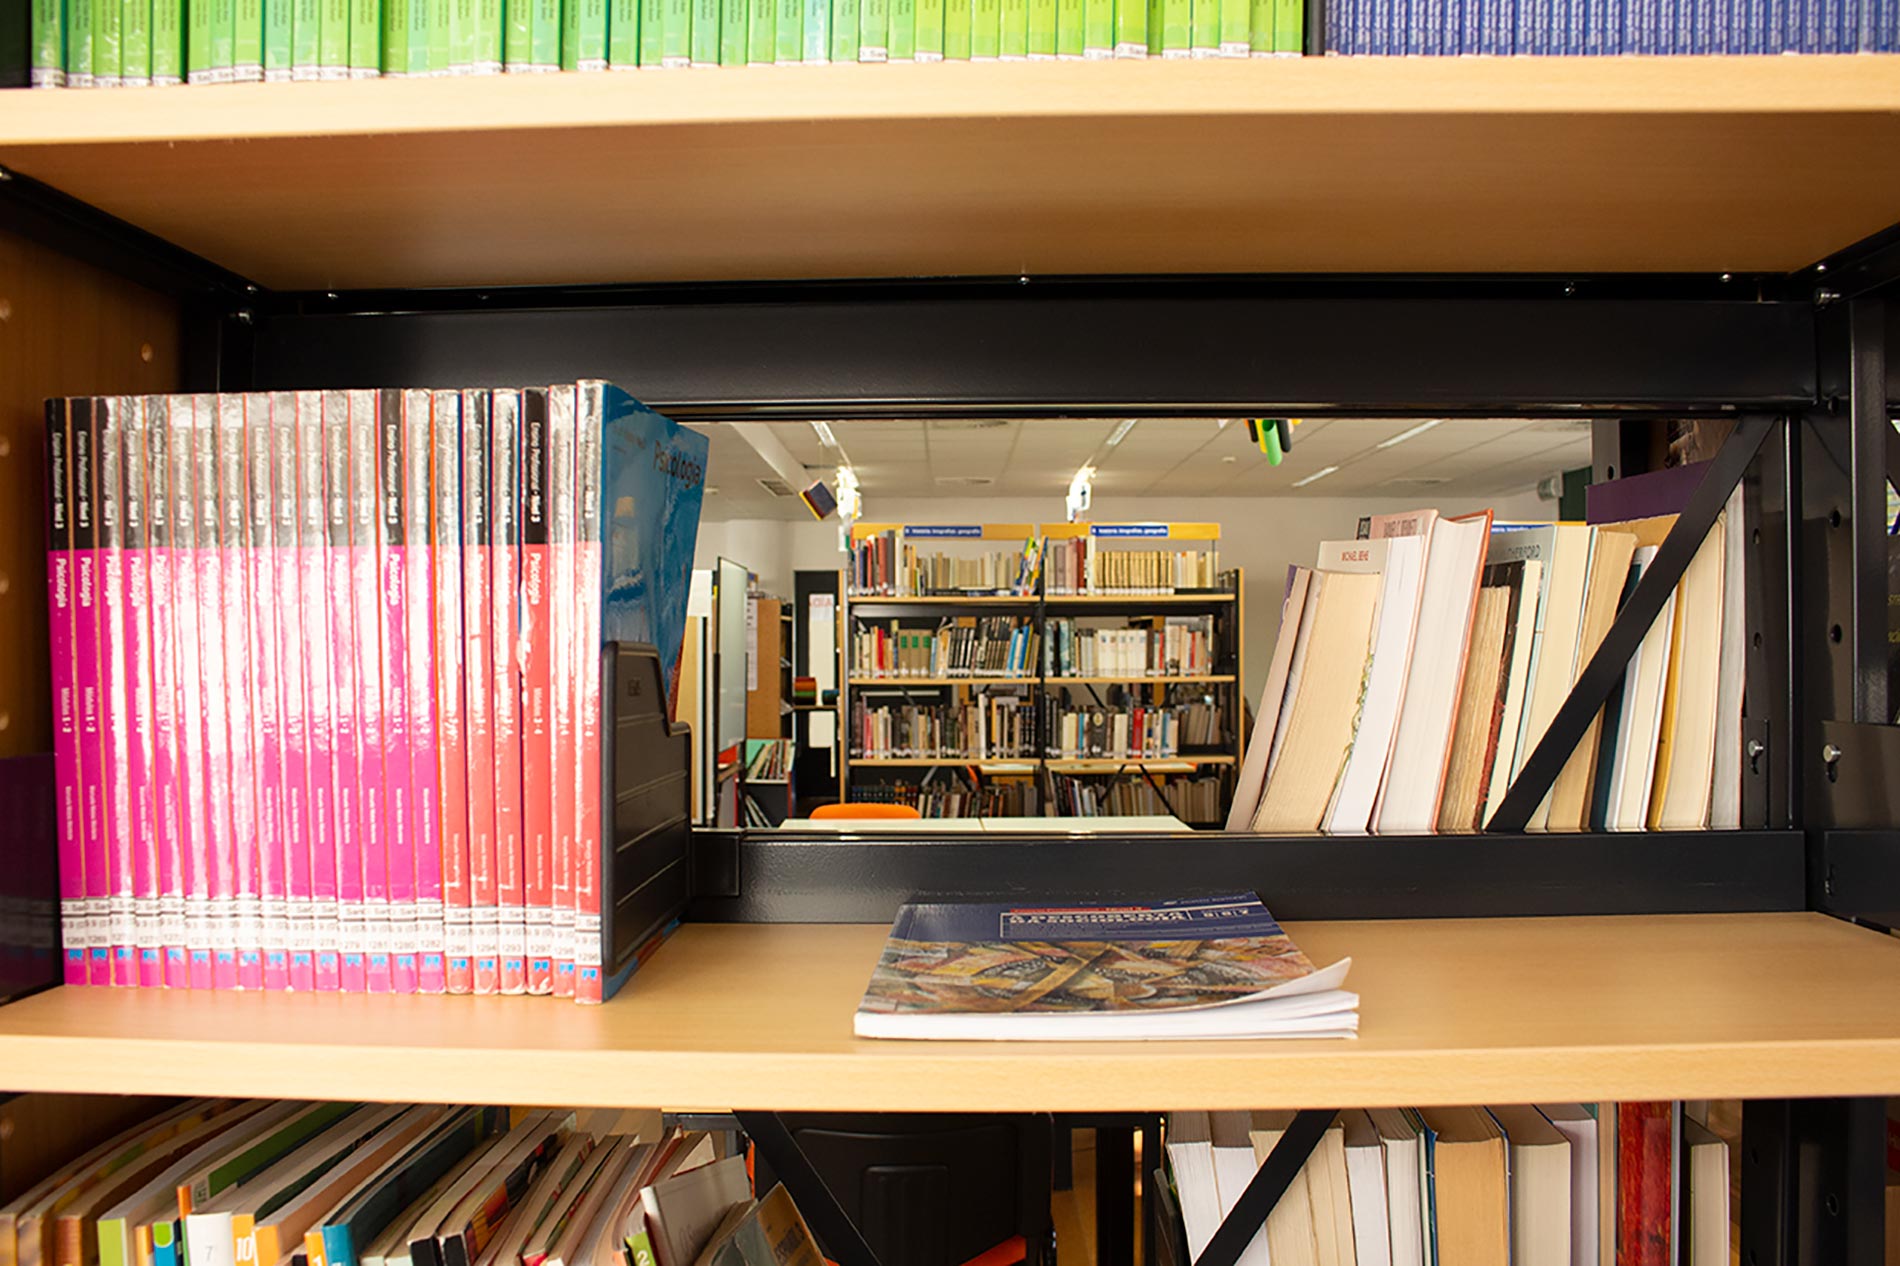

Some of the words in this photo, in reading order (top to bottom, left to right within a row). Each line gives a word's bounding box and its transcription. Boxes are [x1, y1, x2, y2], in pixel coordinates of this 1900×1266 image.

[652, 440, 702, 489] Psicologia
[55, 558, 68, 608] Psicologia
[80, 557, 92, 607] Psicologia
[388, 554, 401, 606] Psicologia
[528, 553, 542, 605] Psicologia
[236, 1236, 253, 1262] 10
